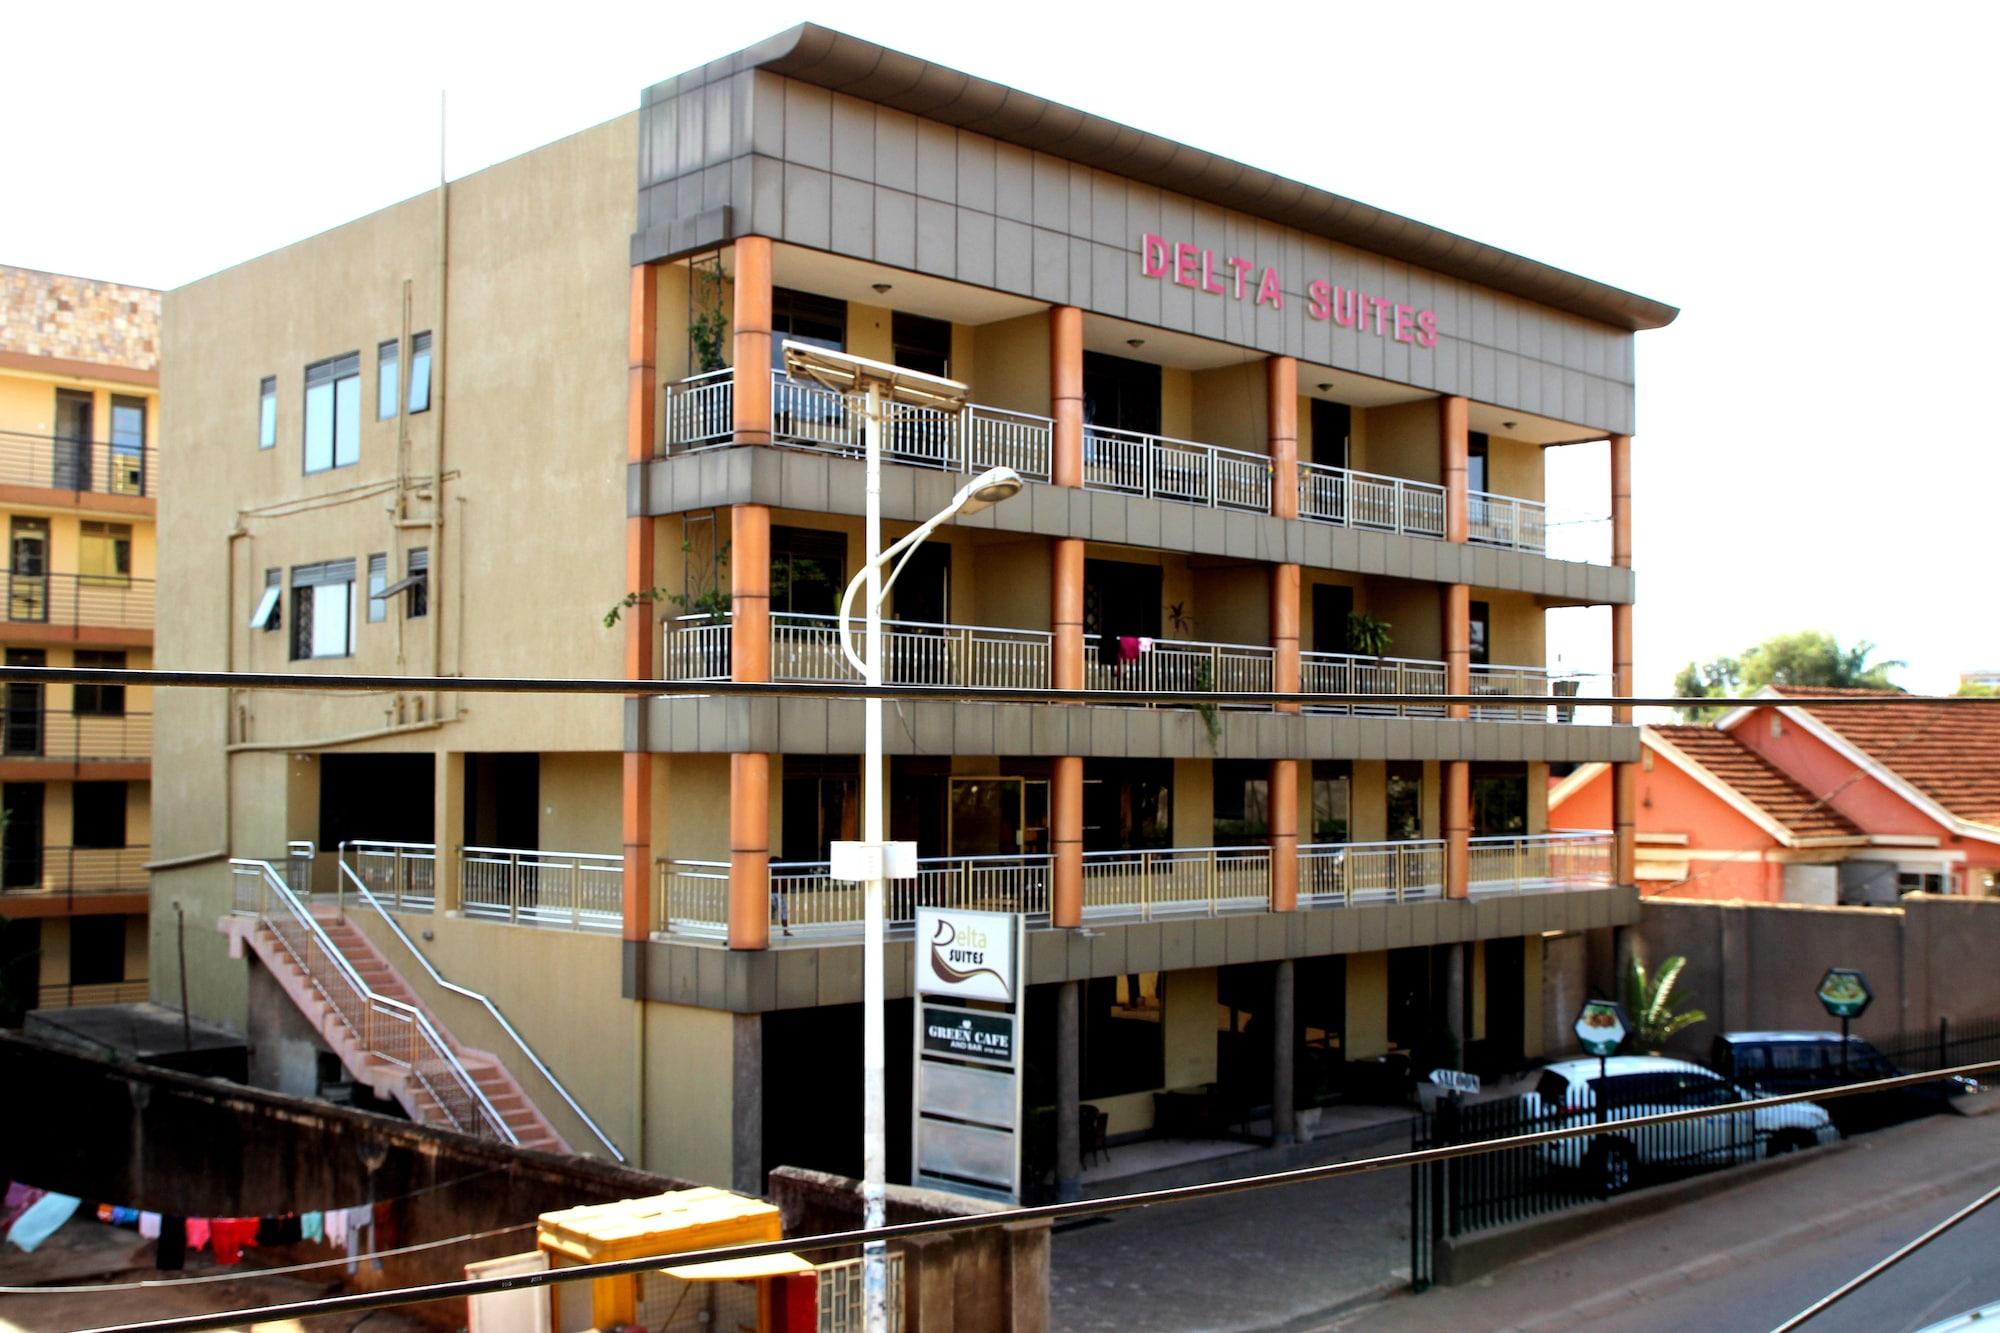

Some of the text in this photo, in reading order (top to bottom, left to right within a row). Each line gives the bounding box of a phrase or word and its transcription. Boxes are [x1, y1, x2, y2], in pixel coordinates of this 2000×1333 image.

[1142, 233, 1438, 348] DELTA SUITES
[931, 919, 987, 948] Delta
[949, 949, 984, 965] SUITES
[928, 1025, 1009, 1048] GREEN CAFE
